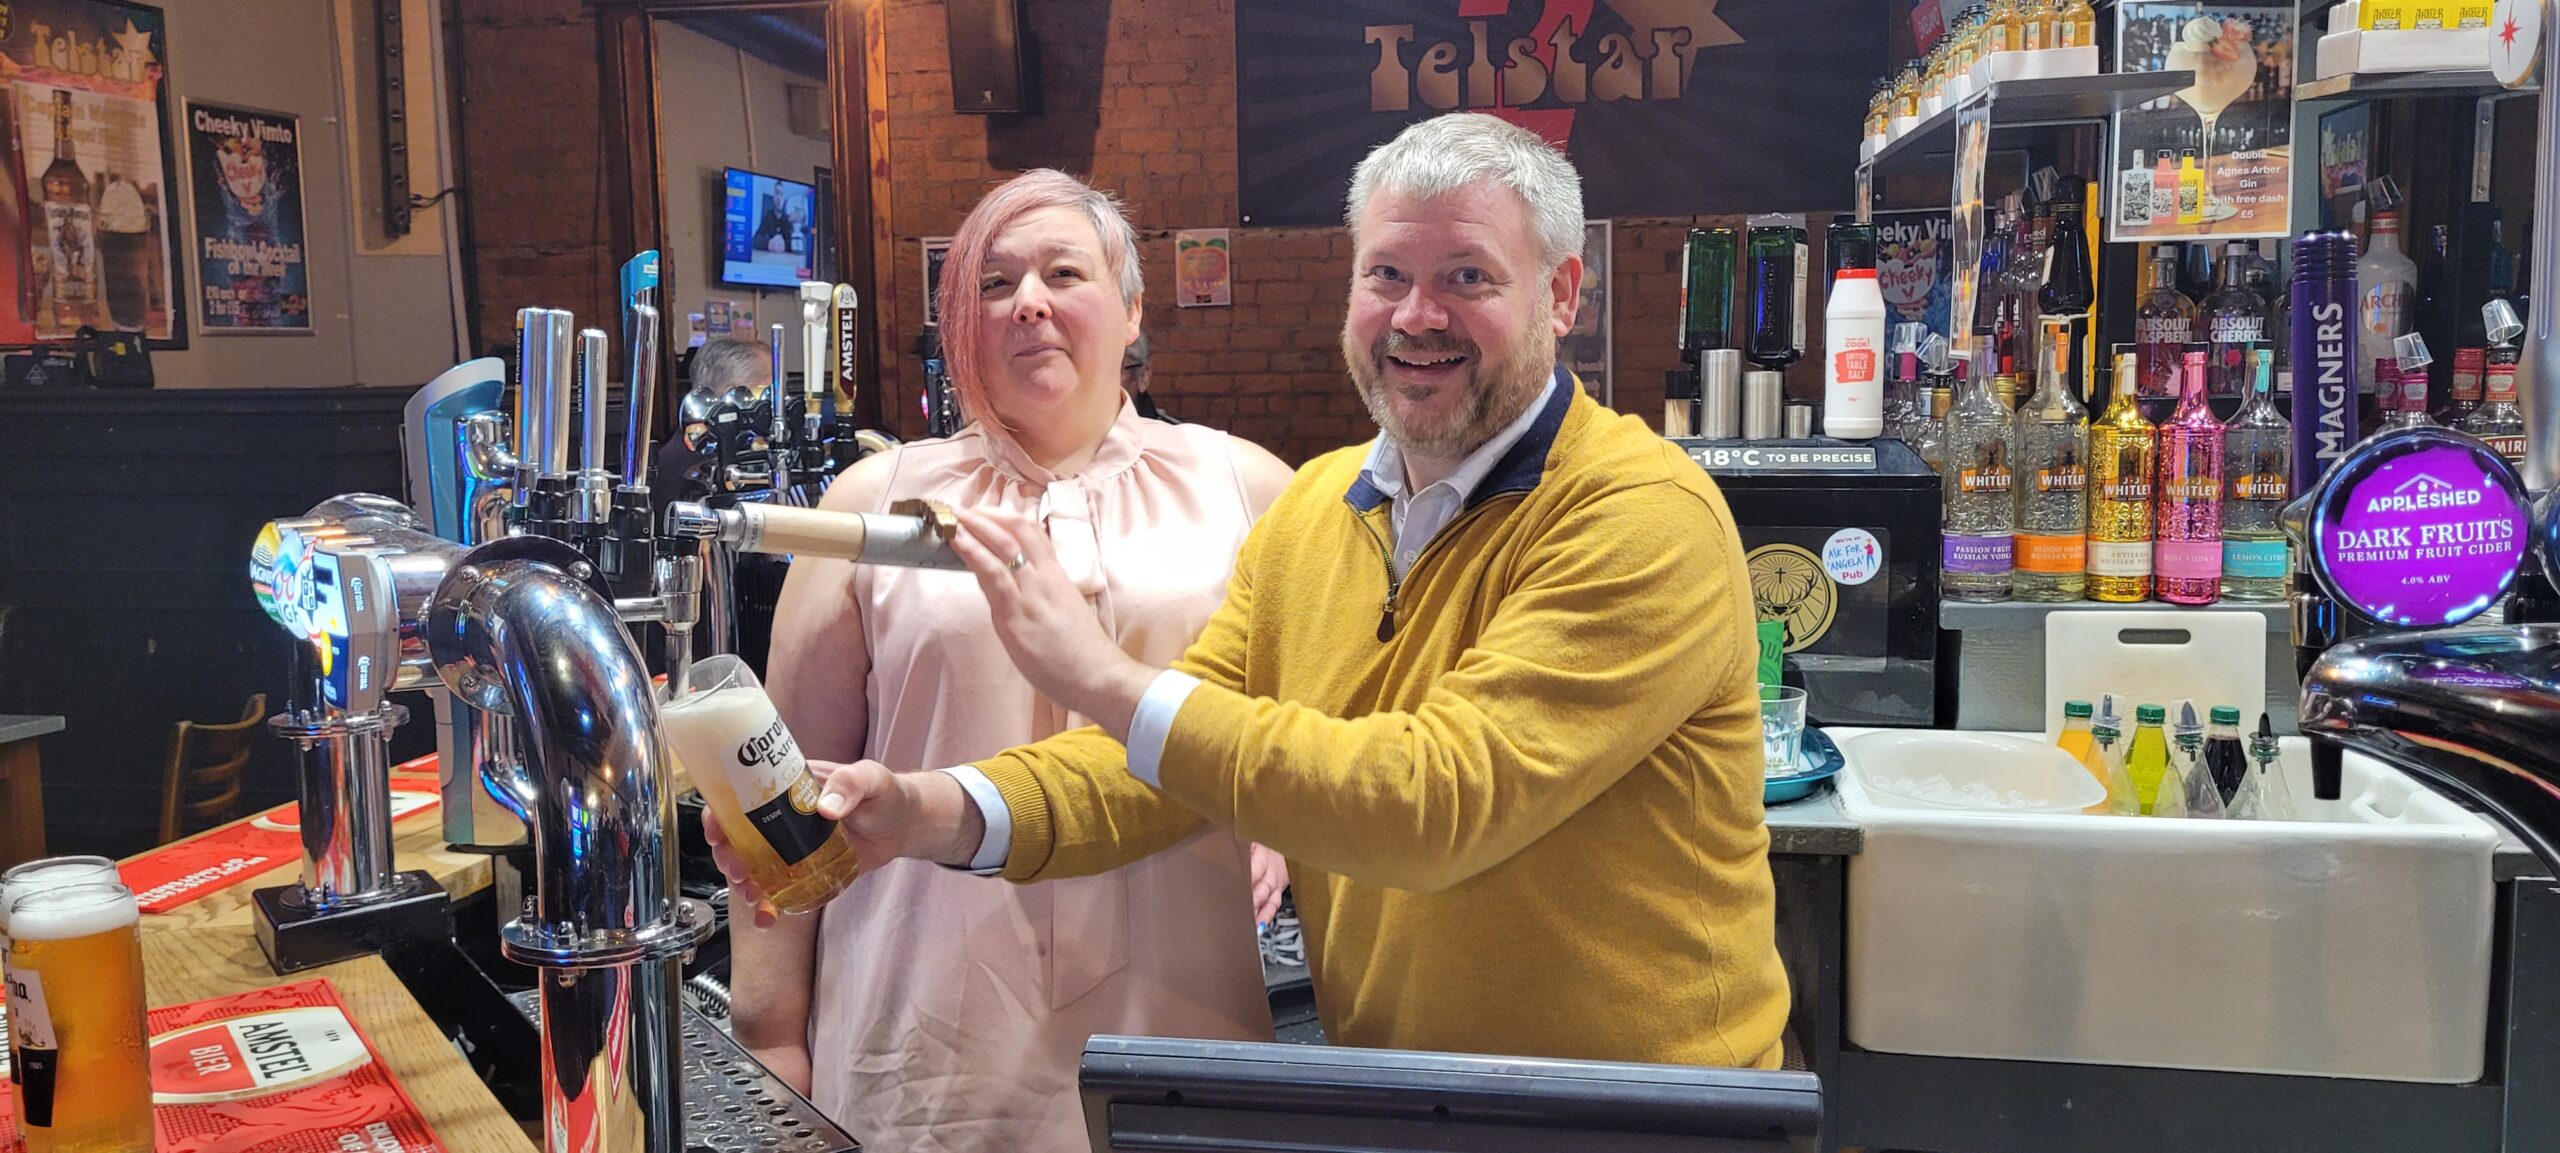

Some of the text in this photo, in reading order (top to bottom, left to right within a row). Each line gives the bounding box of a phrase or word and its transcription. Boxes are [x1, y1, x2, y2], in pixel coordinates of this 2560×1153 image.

[30, 20, 146, 83] Telstar
[1364, 15, 1692, 112] Telstar
[194, 110, 292, 144] Cheeky Vimto
[2231, 151, 2267, 160] Double
[2216, 165, 2281, 177] Agnes Arber
[2239, 179, 2257, 188] Gin
[2213, 193, 2284, 204] with free dash
[2240, 209, 2254, 220] £5
[1876, 221, 1921, 242] eeky
[1880, 264, 1932, 291] Cheeky
[2137, 318, 2191, 331] ABSOLUT
[2210, 317, 2265, 330] ABSOLUT
[2210, 330, 2263, 343] CHERRYS
[842, 309, 854, 382] AMSTEL
[1846, 360, 1868, 370] TABLE
[1848, 370, 1866, 379] SALT
[2312, 303, 2346, 459] MAGNERS
[1692, 449, 1872, 466] -18°C TO BE PRECISE
[1964, 475, 2012, 487] WHITLEY
[2165, 485, 2219, 497] WHITLEY
[2236, 483, 2287, 494] WHITLEY
[2367, 490, 2481, 513] APPLESHED
[2337, 519, 2513, 550] DARK FRUITS
[1828, 544, 1862, 561] ASK FOR
[1956, 546, 1990, 554] PASSION
[2338, 541, 2512, 562] PREMIUM FRUIT CIDER
[1953, 553, 1988, 561] RUSSIAN
[2232, 553, 2261, 561] LEMON
[1842, 570, 1863, 580] Pub
[2401, 575, 2450, 584] 4.0% ABV
[350, 576, 365, 612] Corona
[358, 656, 371, 691] Corona
[761, 808, 783, 824] DESDE
[239, 1021, 312, 1080] AMSTEL
[189, 1044, 232, 1077] BIER
